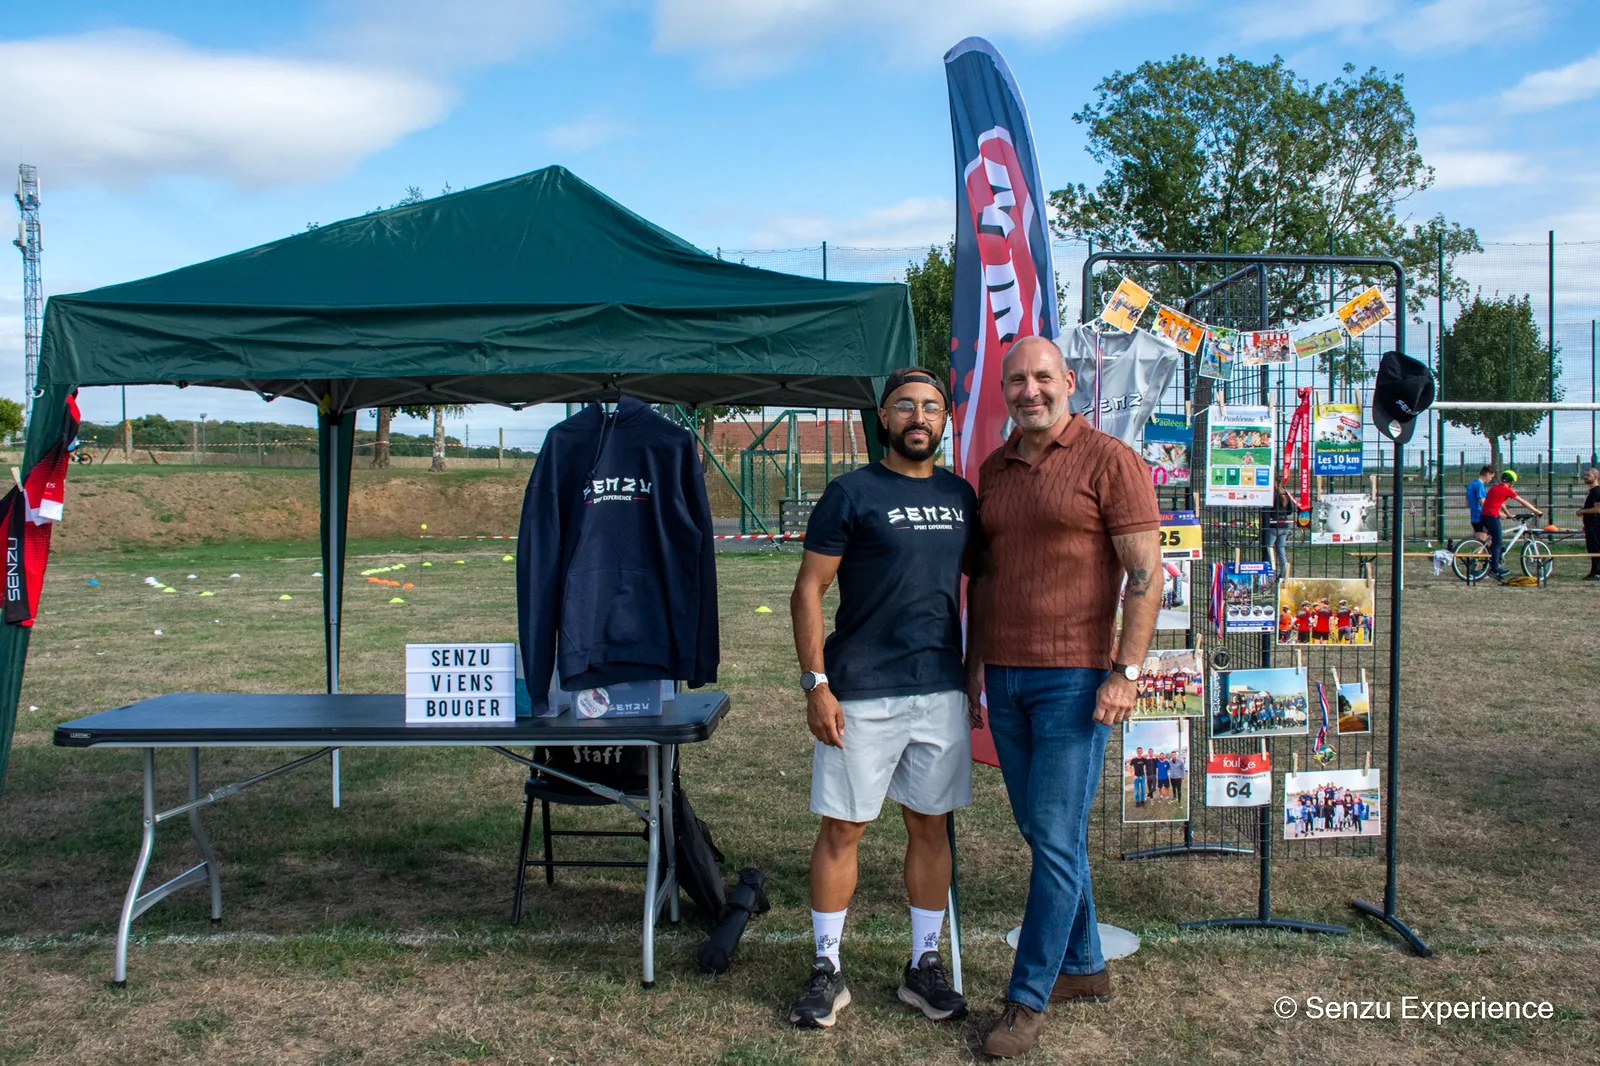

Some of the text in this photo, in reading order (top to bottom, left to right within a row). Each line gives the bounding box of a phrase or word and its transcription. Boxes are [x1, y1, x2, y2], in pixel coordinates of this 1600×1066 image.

[1318, 454, 1360, 464] Les 10 km
[1169, 467, 1189, 478] KM
[887, 506, 964, 524] SENZU
[1340, 509, 1351, 525] 9
[7, 537, 21, 602] SENZU
[431, 649, 490, 667] SENZU
[426, 699, 500, 717] BOUGER
[572, 745, 624, 765] Staff
[1226, 780, 1252, 799] 64
